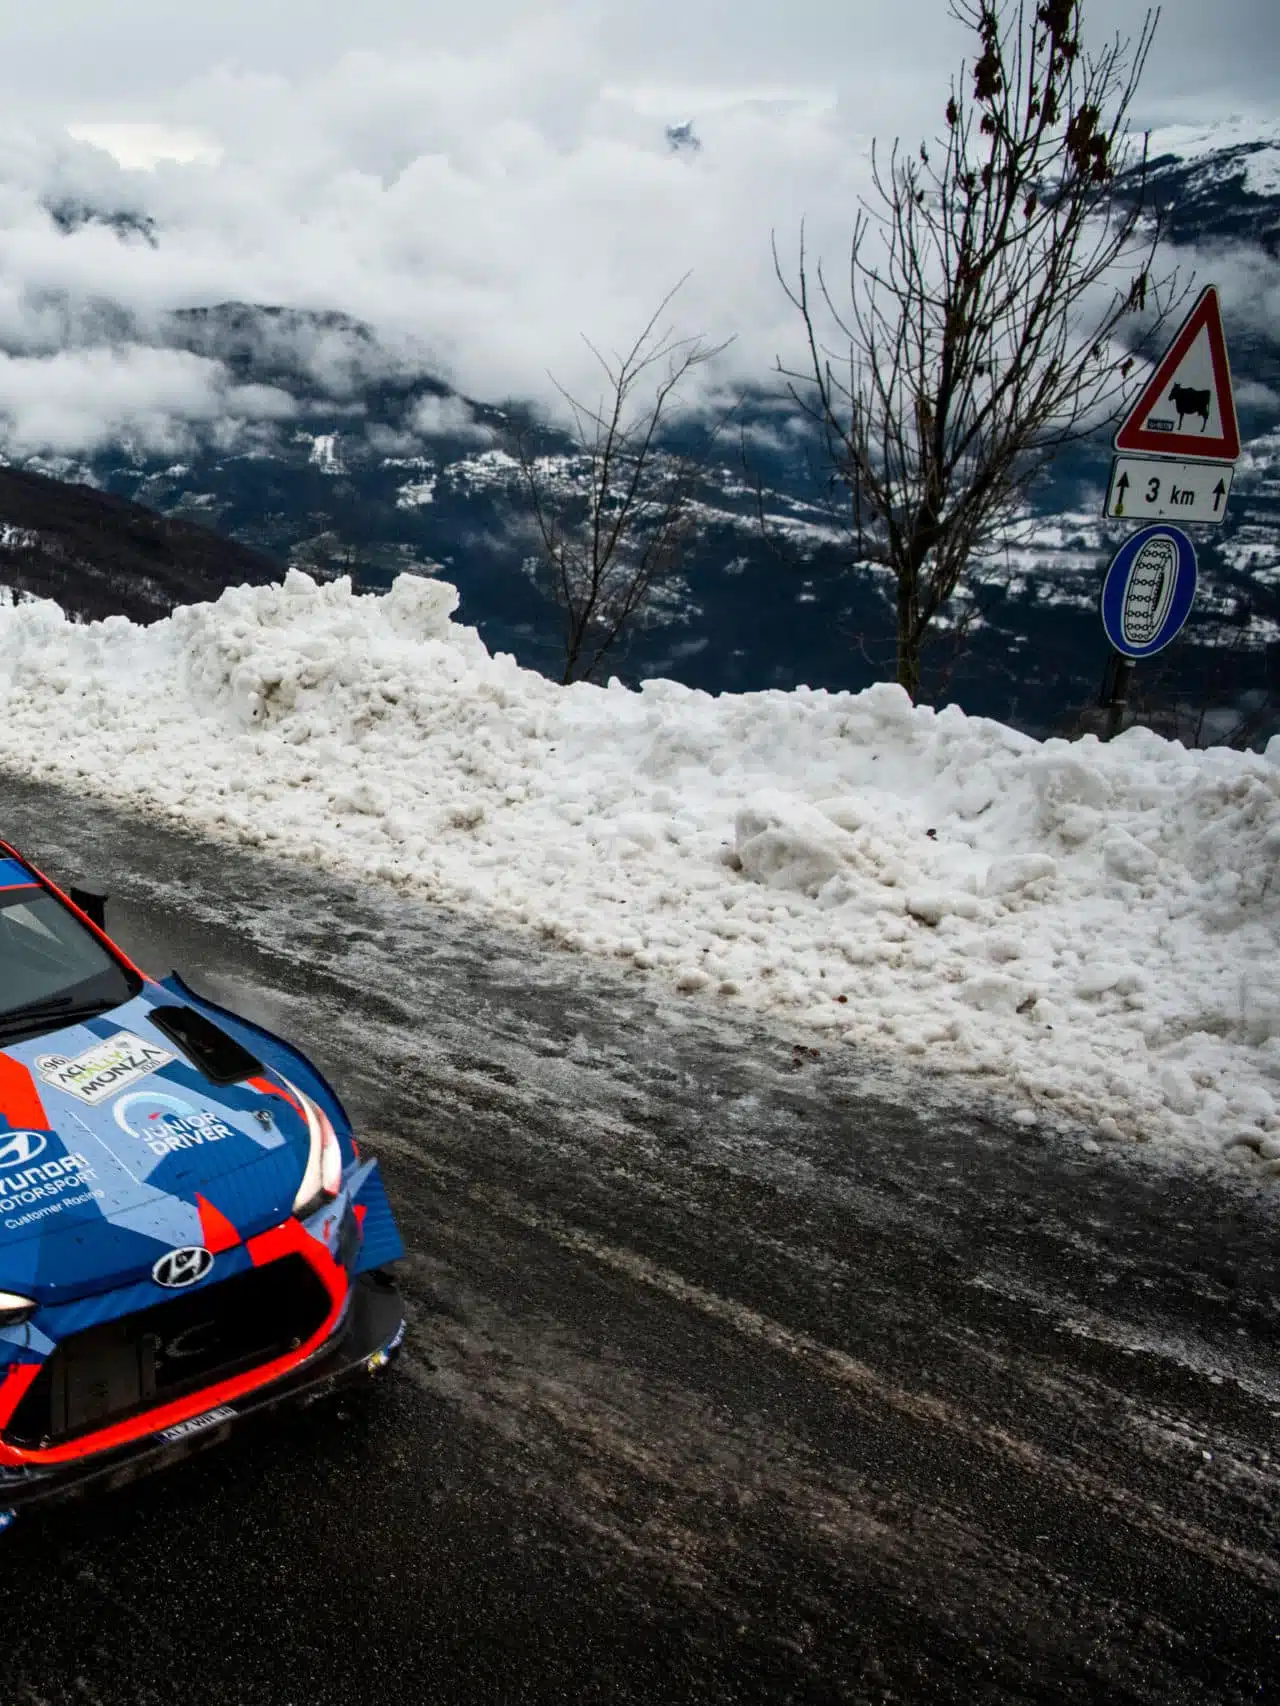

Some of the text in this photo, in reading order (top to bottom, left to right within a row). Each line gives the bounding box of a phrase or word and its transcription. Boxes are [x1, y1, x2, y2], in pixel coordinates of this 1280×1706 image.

[1145, 477, 1195, 506] 3 km
[43, 1057, 66, 1070] 96
[71, 1049, 125, 1084] RALLY
[80, 1048, 161, 1096] MONZA
[141, 1112, 222, 1142] JUNIOR
[148, 1123, 236, 1156] DRIVER
[4, 1188, 106, 1230] Customer Racing
